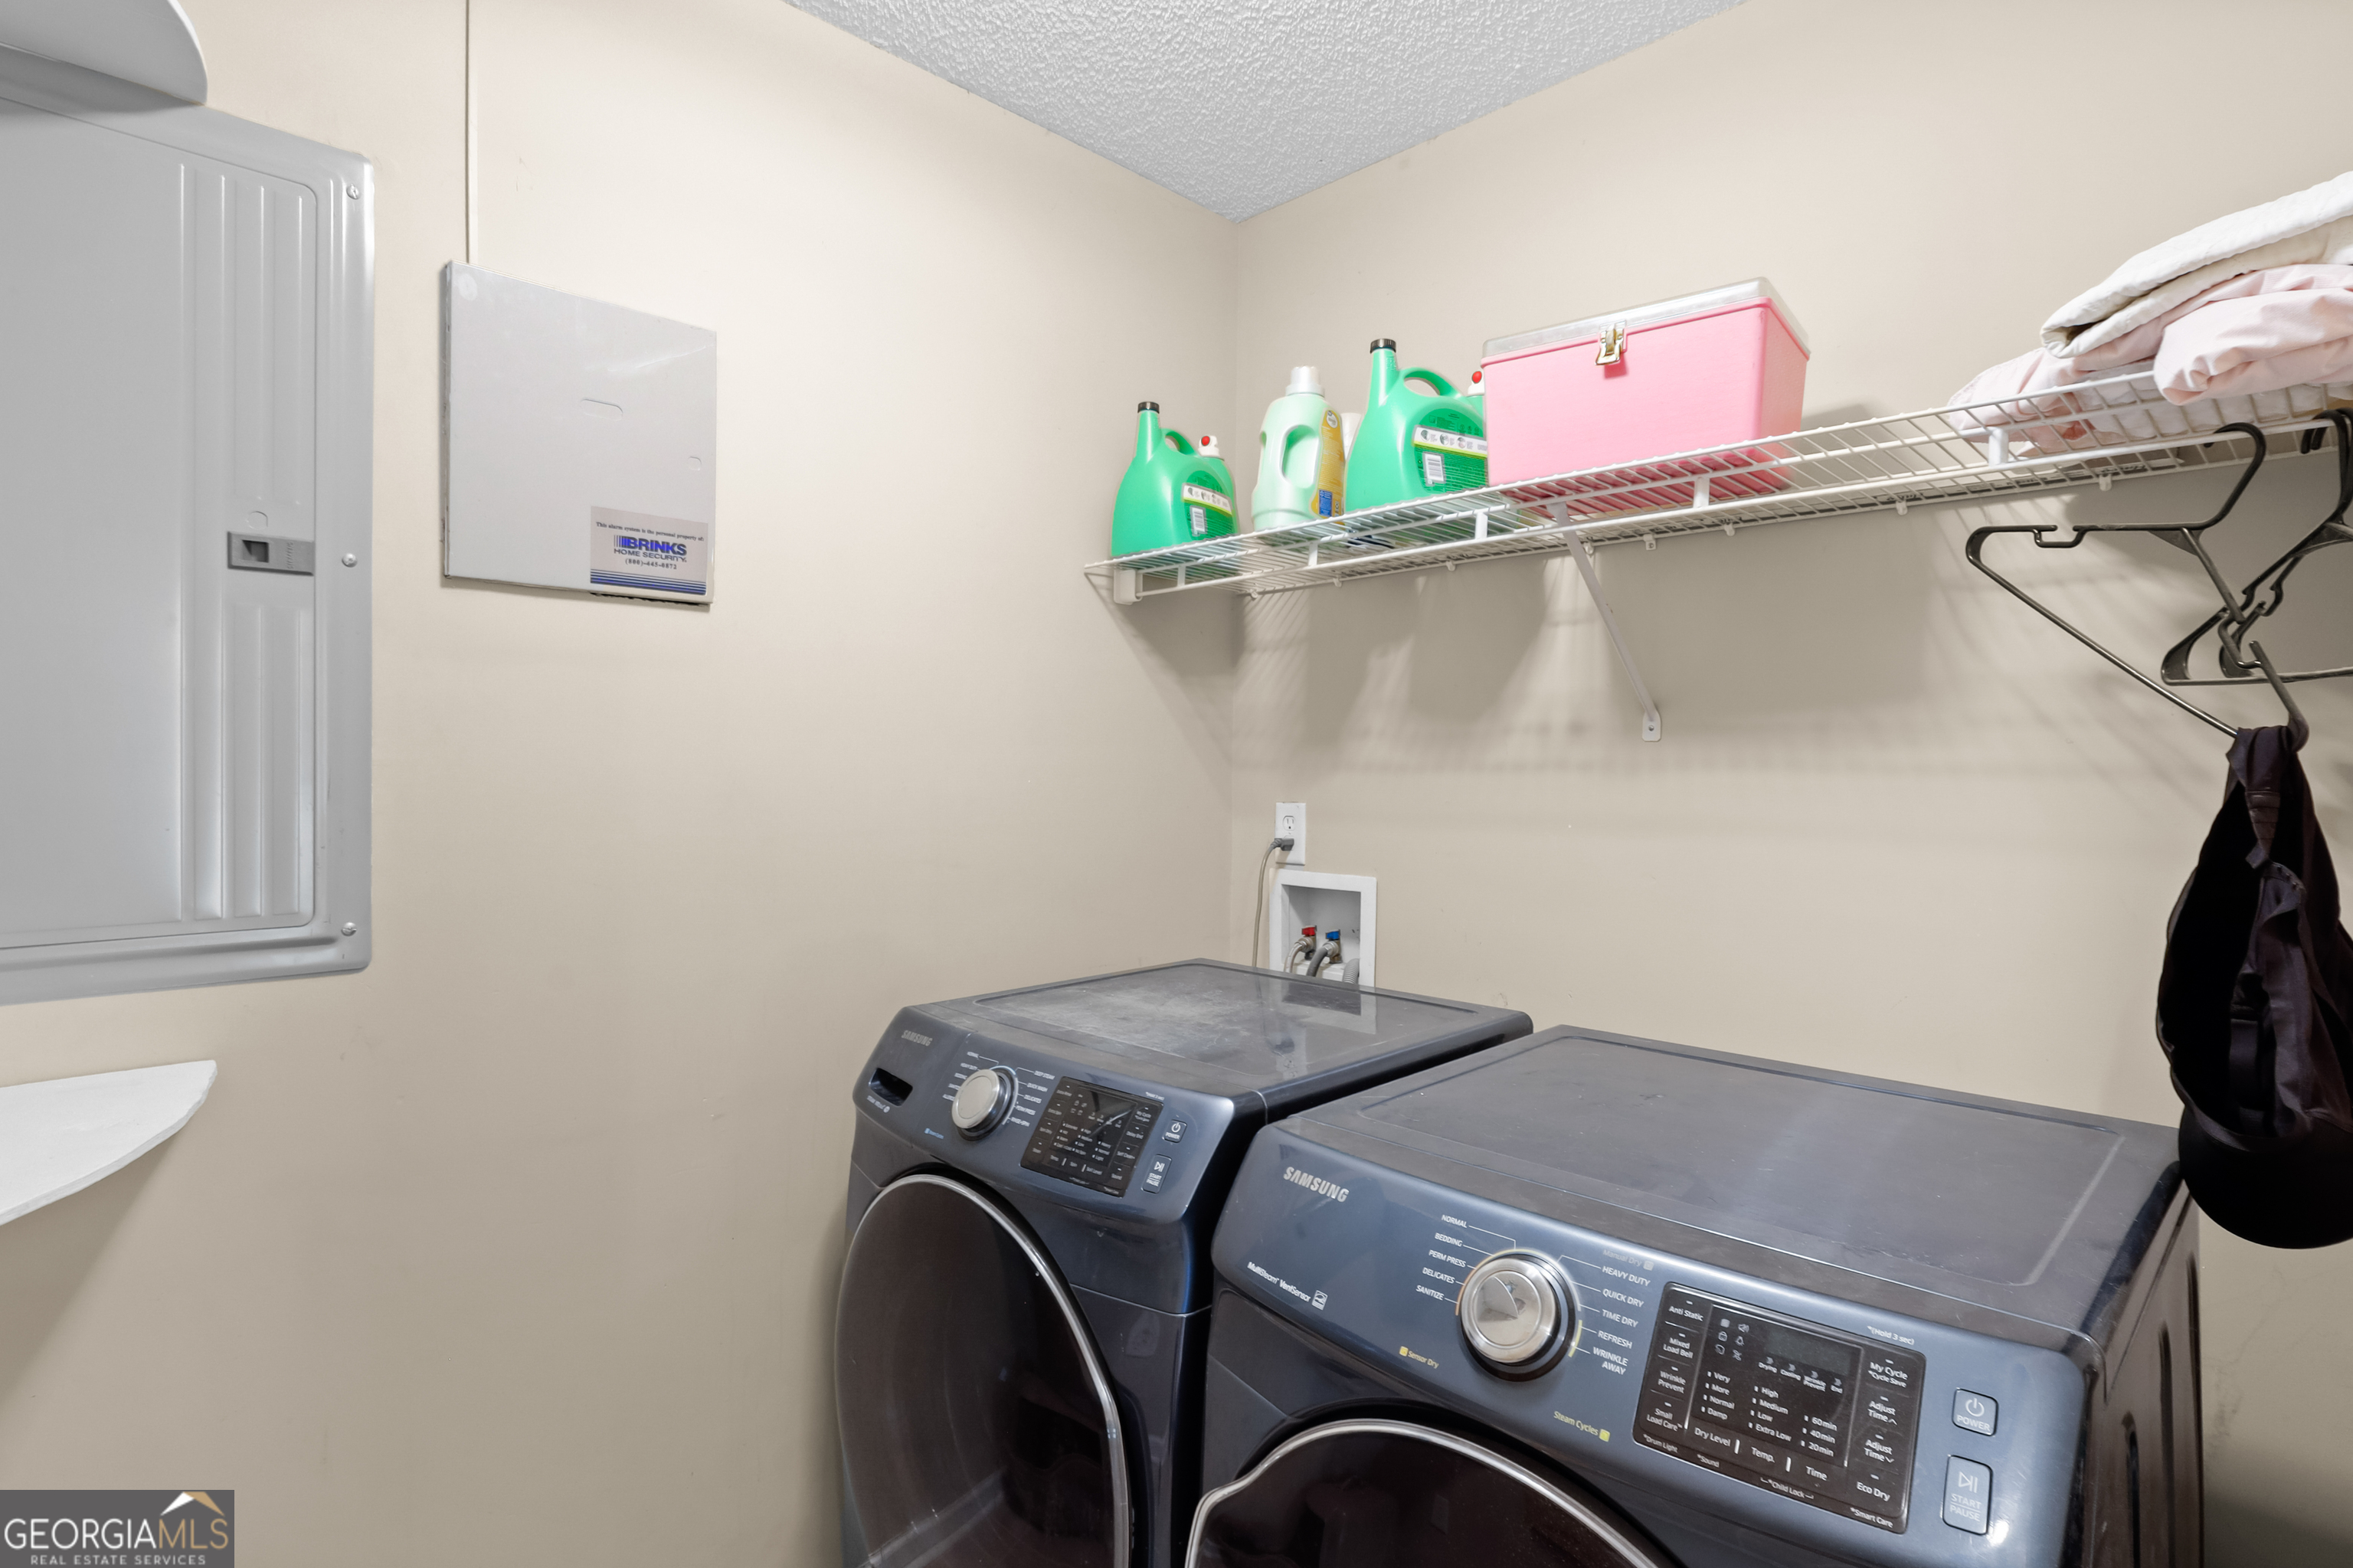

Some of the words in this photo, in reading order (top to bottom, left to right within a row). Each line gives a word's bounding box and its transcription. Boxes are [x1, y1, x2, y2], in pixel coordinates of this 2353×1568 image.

[614, 548, 640, 557] HOME
[627, 535, 687, 556] BRINKS
[902, 1030, 933, 1046] SAMSUNG
[1165, 1131, 1180, 1140] POWER
[1283, 1167, 1349, 1203] SAMSUNG
[1442, 1214, 1467, 1229] NORMAL
[1435, 1232, 1463, 1247] BEDDING
[1428, 1249, 1446, 1261] PERM
[1446, 1255, 1466, 1268] PRESS
[1603, 1249, 1627, 1262] Manual
[1628, 1256, 1642, 1267] Dry
[1422, 1267, 1455, 1284] DELICATES
[1602, 1265, 1628, 1279] HEAVY
[1628, 1274, 1651, 1287] DUTY
[1279, 1278, 1311, 1302] VentSensor
[1415, 1285, 1445, 1301] SANITIZE
[1602, 1288, 1627, 1302] QUICK
[1627, 1297, 1644, 1308] DRY
[1602, 1309, 1621, 1322] TIME
[1622, 1316, 1638, 1327] DRY
[1669, 1305, 1683, 1315] Anti
[1684, 1310, 1703, 1321] Static
[1598, 1331, 1633, 1349] REFRESH
[1669, 1337, 1690, 1349] Mixed
[1593, 1347, 1628, 1367] WRINKLE
[1663, 1344, 1680, 1354] Load
[1680, 1348, 1694, 1359] Bell
[1408, 1350, 1428, 1363] Sensor
[1427, 1358, 1439, 1370] Dry
[1602, 1360, 1626, 1375] AWAY
[1660, 1370, 1686, 1385] Wrinkle
[1714, 1372, 1731, 1383] Very
[1870, 1361, 1884, 1373] My
[1884, 1367, 1908, 1380] Cycle
[1658, 1379, 1684, 1394] Prevent
[1710, 1383, 1730, 1395] More
[1890, 1377, 1907, 1388] Save
[1761, 1386, 1779, 1399] High
[1709, 1395, 1735, 1409] Normal
[1759, 1399, 1788, 1415] Medium
[1869, 1400, 1896, 1416] Adjust
[1646, 1414, 1663, 1426] Load
[1654, 1408, 1673, 1420] Small
[1707, 1407, 1728, 1420] Damp
[1757, 1411, 1773, 1422] Low
[1867, 1408, 1888, 1422] Time
[1553, 1411, 1576, 1426] Steam
[1576, 1420, 1599, 1435] Cycles
[1956, 1414, 1991, 1432] POWER
[1694, 1427, 1709, 1439] Dry
[1710, 1432, 1731, 1447] Level
[1756, 1422, 1775, 1436] Extra
[1775, 1430, 1792, 1442] Low
[1662, 1442, 1678, 1453] Light
[1751, 1446, 1775, 1463] Temp.
[1864, 1447, 1885, 1462] Time
[1865, 1439, 1893, 1455] Adjust
[1805, 1465, 1828, 1481] Time
[1789, 1487, 1805, 1498] Lock
[1856, 1481, 1873, 1494] Eco
[1874, 1488, 1890, 1502] Dry
[1951, 1494, 1982, 1510] START
[1949, 1504, 1981, 1522] PAUSE
[1876, 1517, 1893, 1528] Care
